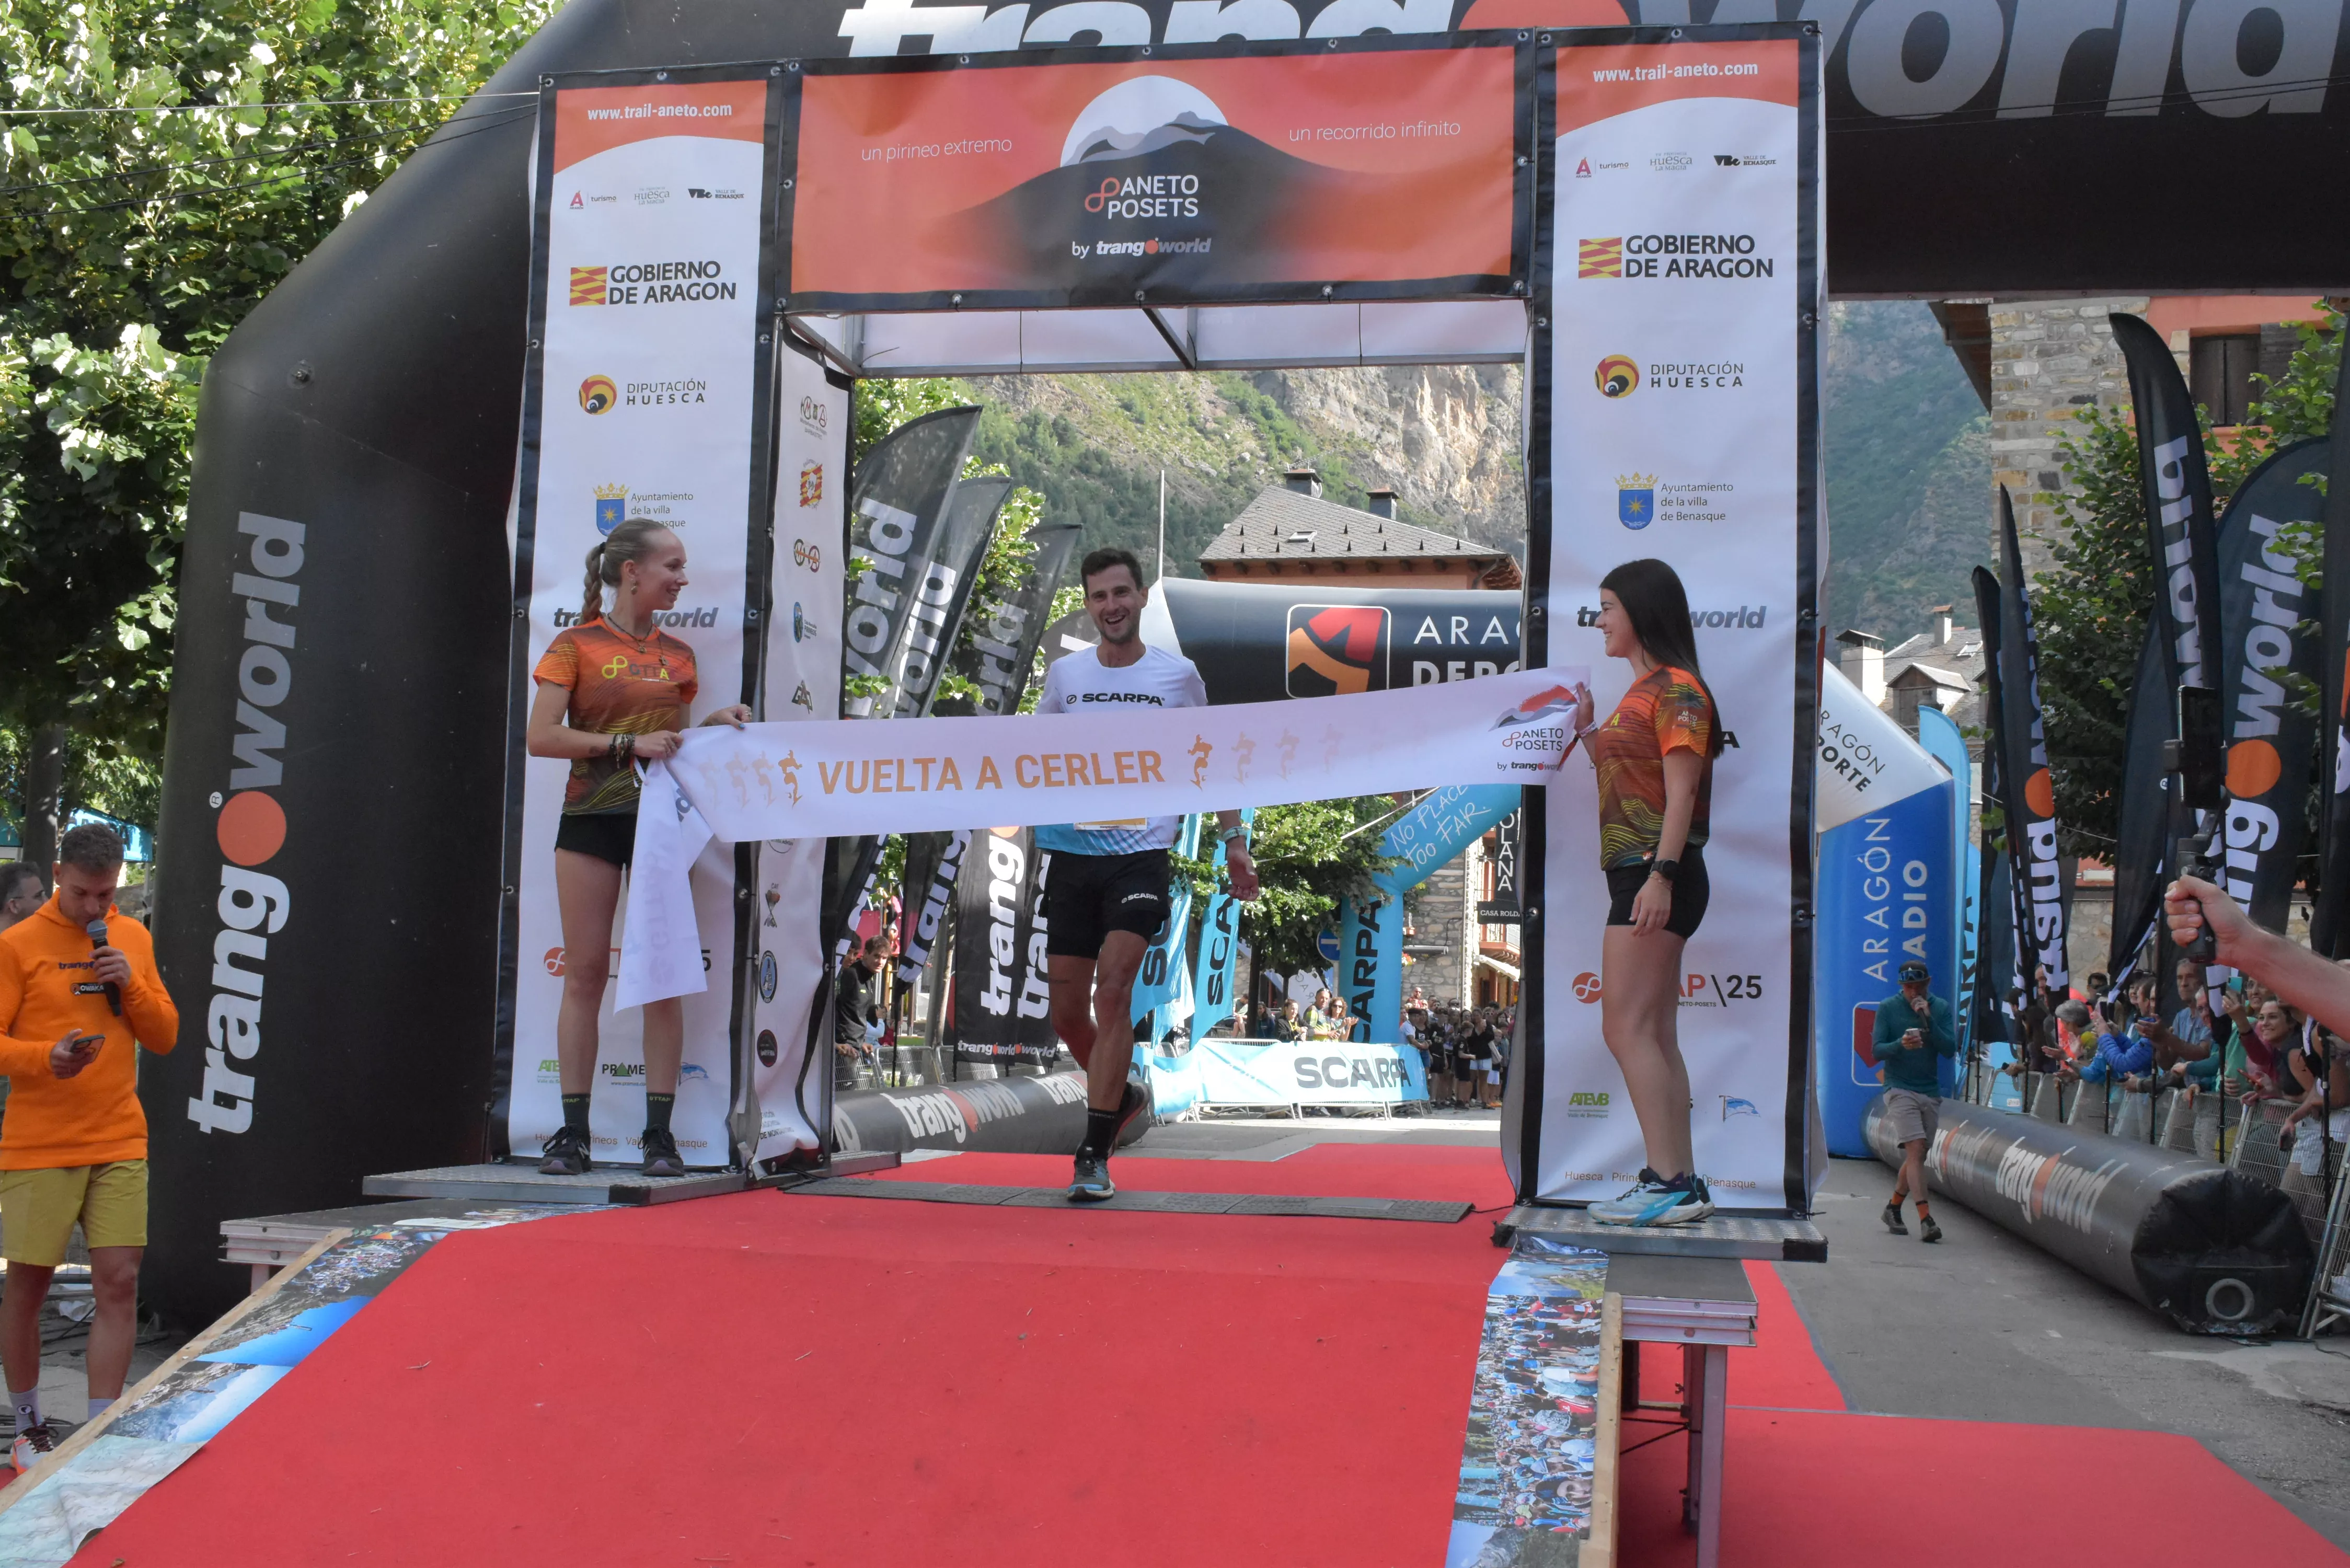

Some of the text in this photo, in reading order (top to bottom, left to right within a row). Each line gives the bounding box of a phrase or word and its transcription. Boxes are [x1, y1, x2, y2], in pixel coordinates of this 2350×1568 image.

[1593, 62, 1758, 82] www.trail-aneto.com
[588, 103, 732, 120] www.trail-aneto.com
[1289, 121, 1460, 142] un recorrido infinito
[861, 139, 1012, 163] un pirineo extremo
[1120, 175, 1199, 197] ANETO
[1108, 198, 1199, 220] POSETS
[1072, 241, 1090, 259] by
[1626, 234, 1755, 254] GOBIERNO
[610, 261, 721, 283] GOBIERNO
[1626, 258, 1773, 278] DE ARAGON
[609, 282, 736, 305] DE ARAGON
[1651, 361, 1744, 375] DIPUTACIÓN
[627, 378, 706, 394] DIPUTACIÓN
[1651, 376, 1743, 388] HUESCA
[627, 393, 705, 405] HUESCA
[631, 492, 694, 503] Ayuntamiento
[1661, 482, 1734, 494] Ayuntamiento
[631, 504, 670, 514] de la villa
[1661, 496, 1708, 506] de la villa
[660, 518, 686, 528] asque
[1661, 511, 1726, 522] de Benasque
[1414, 616, 1521, 644] ARA
[1081, 693, 1162, 706] SCARPA
[1522, 728, 1564, 739] ANETO
[1819, 710, 1886, 775] RAGÓN
[1516, 740, 1563, 751] POSETS
[818, 750, 1165, 794] VUELTA A CERLER
[1497, 762, 1507, 771] by
[1391, 786, 1468, 852] NO PLACE
[1406, 843, 1436, 871] TOO
[1127, 893, 1158, 901] SCARPA
[1857, 818, 1891, 982] ARAGÓN
[1903, 860, 1928, 960] ADIO
[1348, 900, 1381, 1043] CARPA
[1294, 1057, 1412, 1089] SCARPA
[1565, 1171, 1756, 1189] Huesca Pirine Benasque
